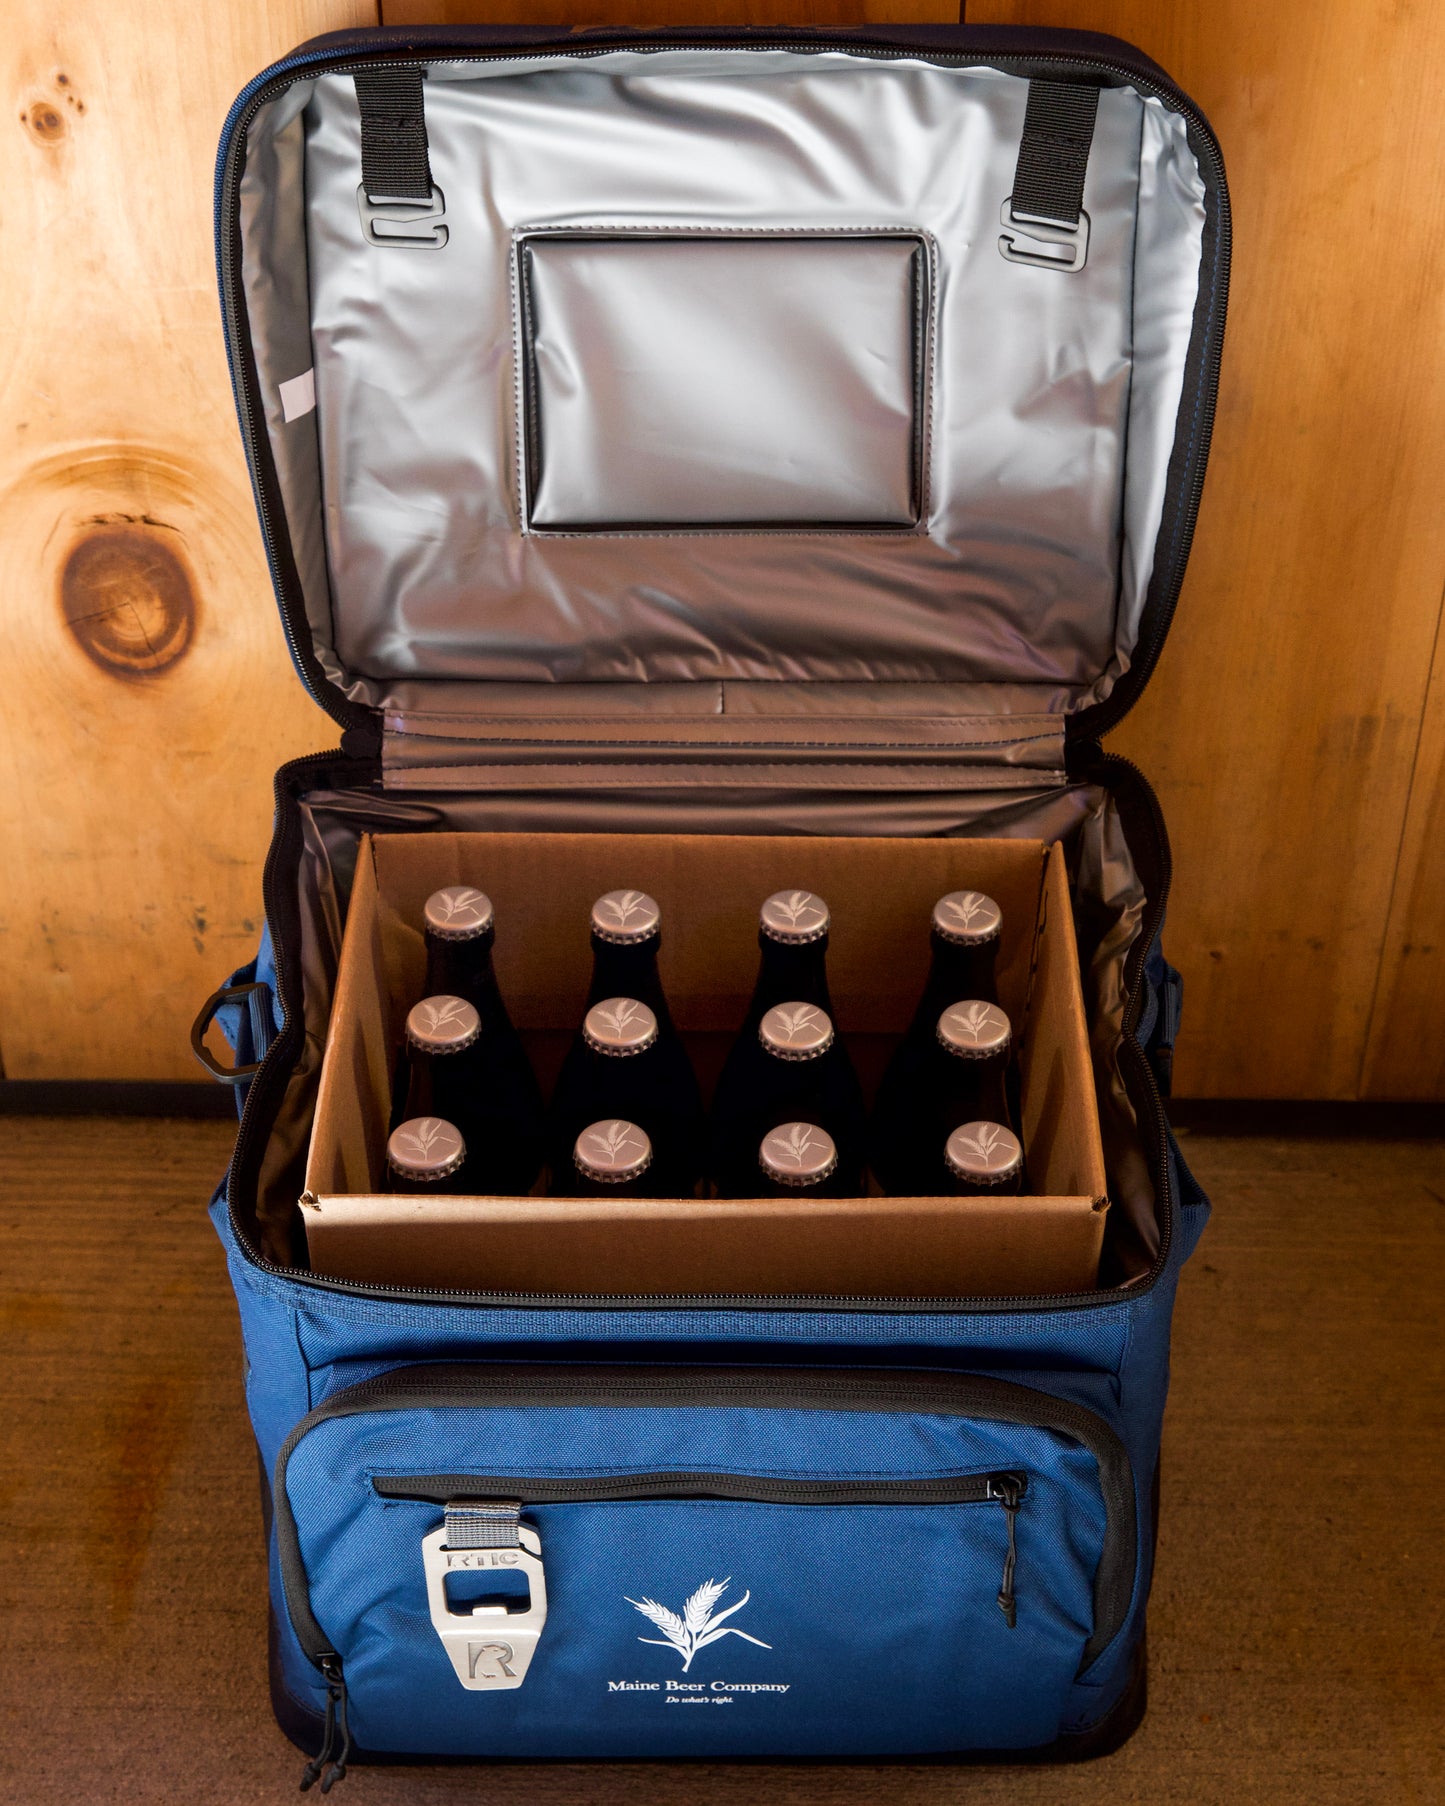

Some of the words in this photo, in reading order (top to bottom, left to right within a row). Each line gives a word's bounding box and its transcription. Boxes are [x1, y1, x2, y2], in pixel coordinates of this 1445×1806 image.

[447, 1552, 519, 1567] RTIC
[608, 1680, 660, 1692] Maine
[665, 1681, 705, 1691] Beer
[710, 1681, 791, 1693] Company
[665, 1696, 680, 1704] Do
[681, 1696, 710, 1704] what's
